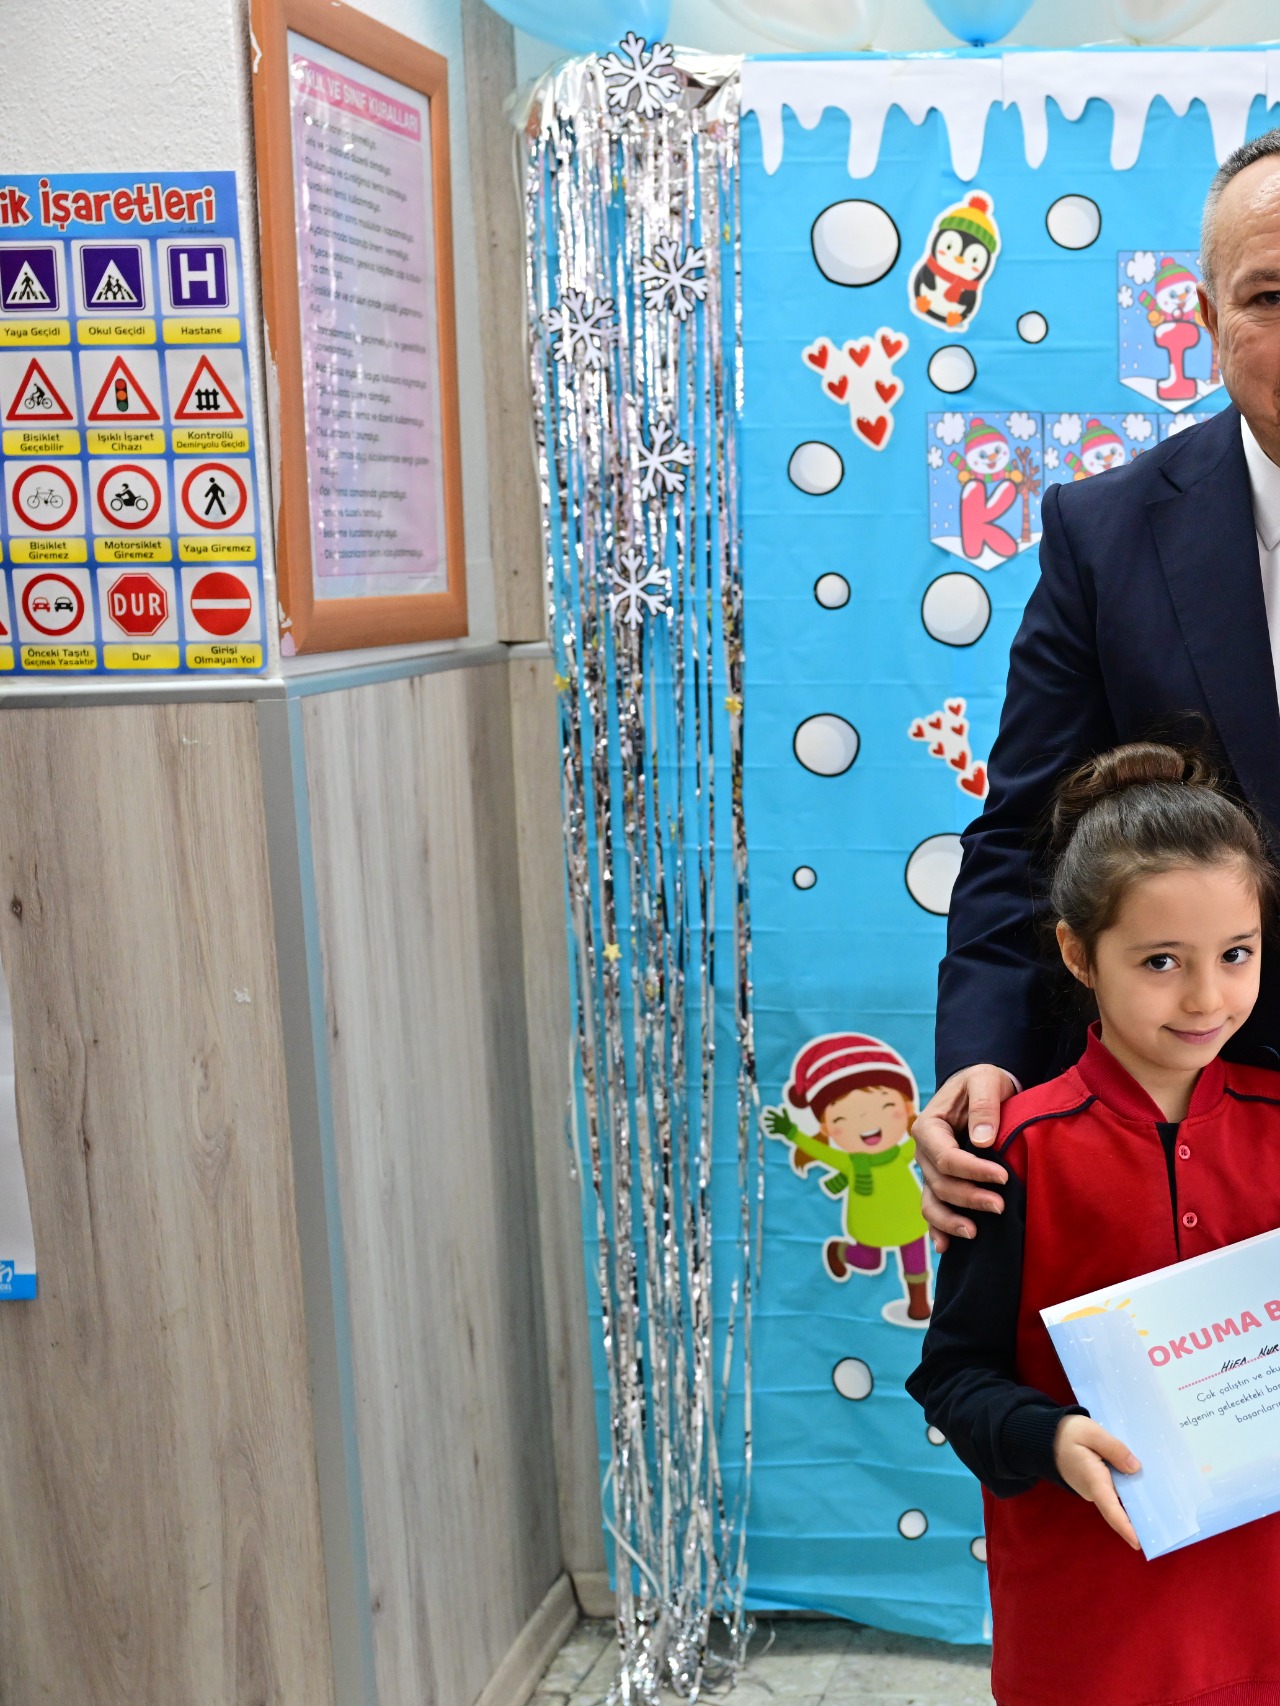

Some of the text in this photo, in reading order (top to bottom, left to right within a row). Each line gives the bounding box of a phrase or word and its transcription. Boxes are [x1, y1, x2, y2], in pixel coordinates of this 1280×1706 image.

[39, 178, 216, 231] İşaretleri
[179, 252, 217, 300] H
[4, 327, 61, 338] Yaya Geçidi
[88, 326, 146, 337] Okul Geçidi
[181, 326, 222, 335] Hastane
[23, 433, 60, 442] Bisiklet
[187, 431, 234, 440] Kontrollü
[20, 442, 64, 453] Geçebilir
[176, 439, 246, 450] Demiryolu Geçidi
[30, 541, 67, 550] Bisiklet
[104, 541, 162, 550] Motorsiklet
[183, 544, 251, 555] Yaya Giremez
[28, 551, 69, 560] Giremez
[114, 550, 154, 559] Giremez
[113, 592, 163, 616] DUR
[27, 648, 60, 658] Önceki
[211, 645, 238, 656] Girişi
[132, 652, 151, 661] Dur
[194, 655, 256, 666] Olmayan Yol
[1147, 1310, 1262, 1367] OKUMA
[1196, 1389, 1216, 1403] Çok
[1219, 1379, 1250, 1395] çalıştın
[1252, 1373, 1263, 1381] ve
[1217, 1389, 1265, 1416] gelecekteki
